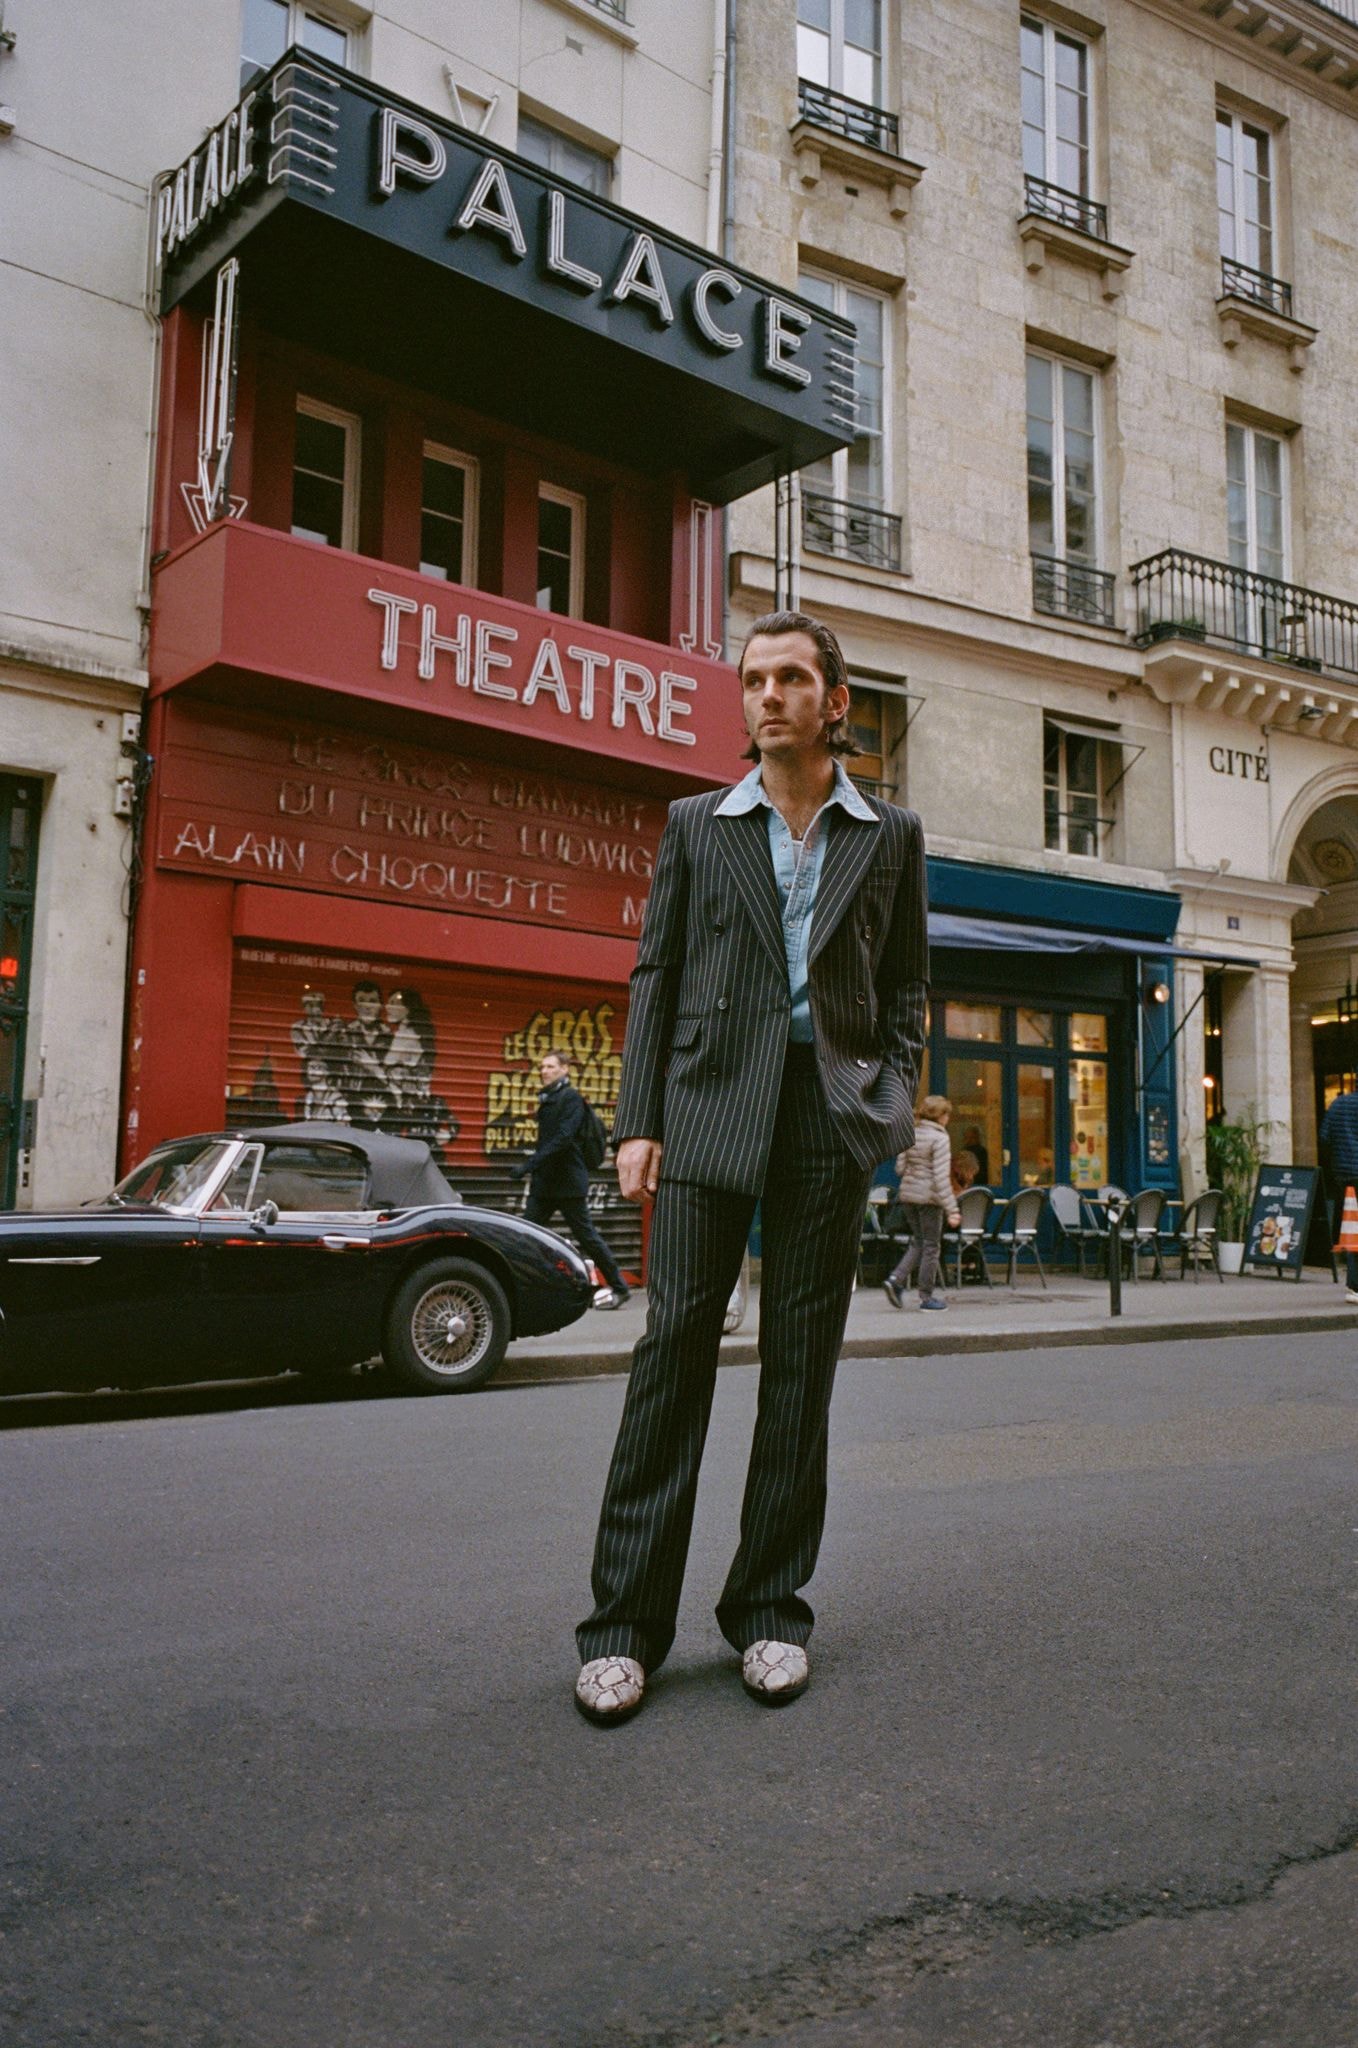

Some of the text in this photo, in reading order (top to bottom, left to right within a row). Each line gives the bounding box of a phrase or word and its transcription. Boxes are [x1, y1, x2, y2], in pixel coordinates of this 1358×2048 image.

[157, 91, 256, 267] PALACE
[377, 107, 812, 388] PALACE
[368, 588, 698, 746] THEATRE
[1209, 746, 1270, 783] CITÉ
[174, 823, 305, 873] ALAIN
[331, 845, 567, 914] CHOQUETTE
[279, 780, 653, 878] DU PRINCE LUDWIG
[504, 1002, 616, 1066] LE GROS
